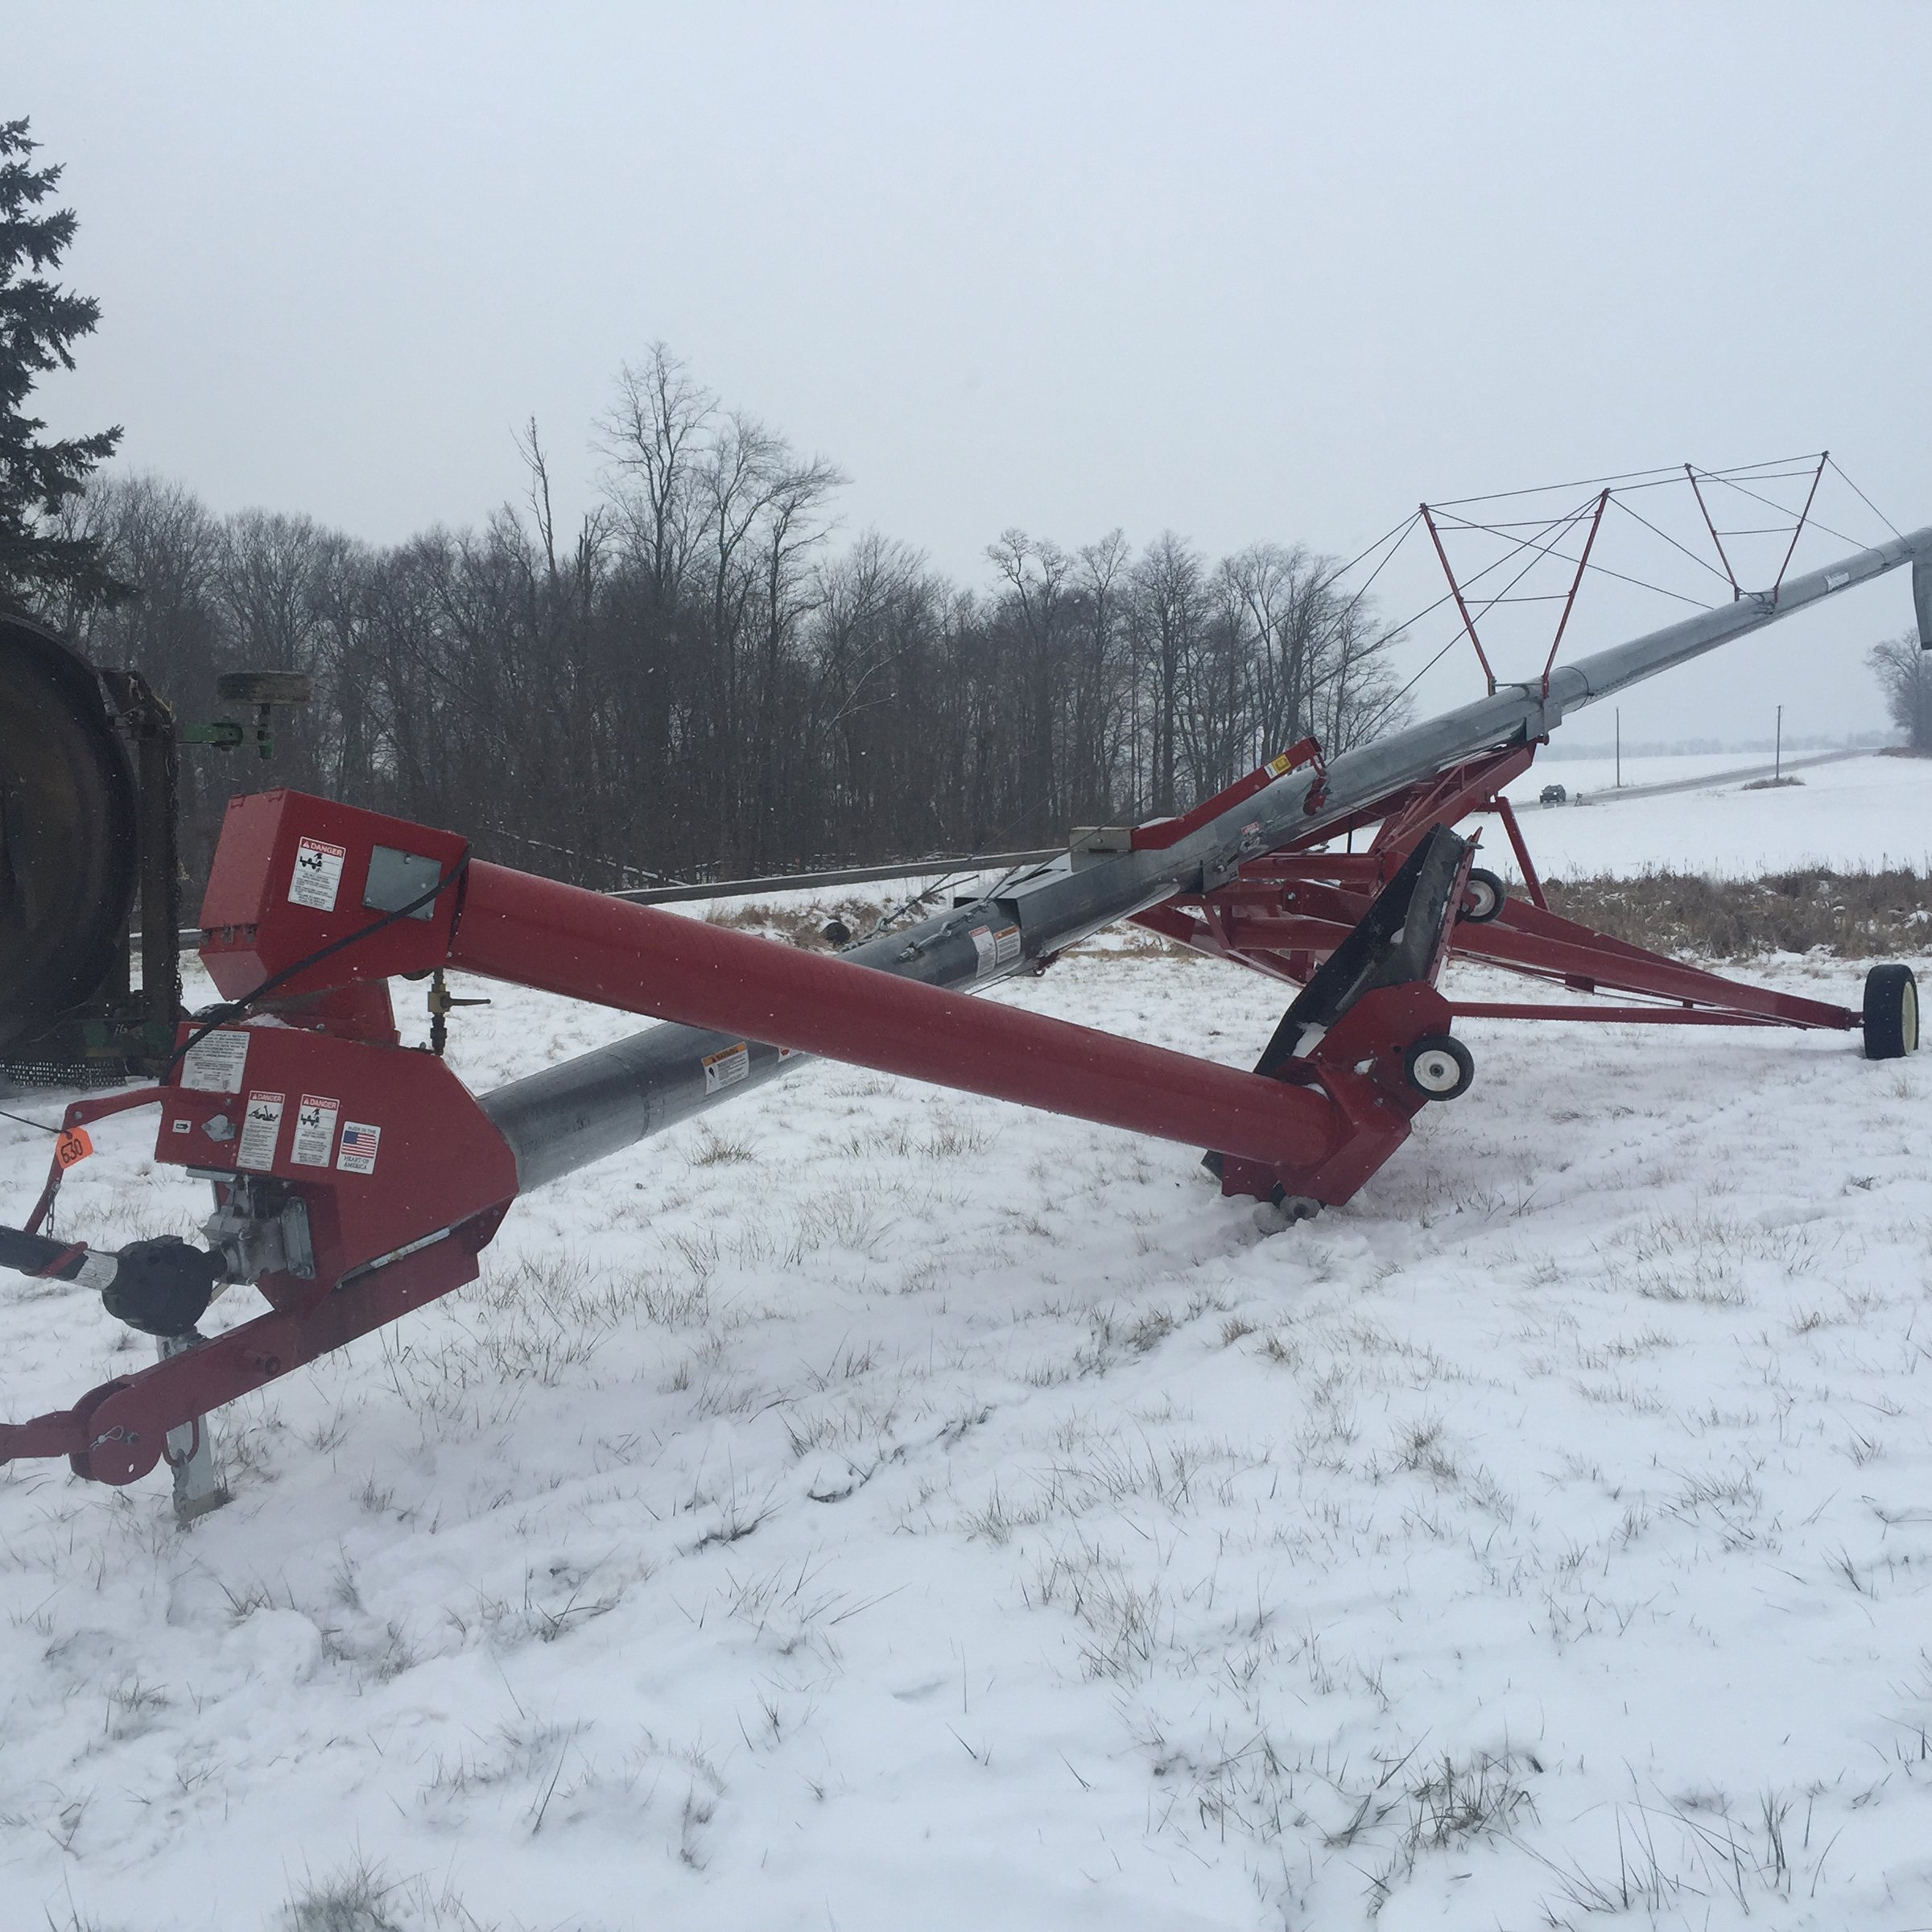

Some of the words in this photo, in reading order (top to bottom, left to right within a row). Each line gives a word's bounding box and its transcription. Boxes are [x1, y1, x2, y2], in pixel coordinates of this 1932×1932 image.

[311, 842, 343, 857] DANGER
[258, 1094, 282, 1102] DANGER
[309, 1100, 336, 1108] DANGER
[61, 1138, 84, 1164] 630
